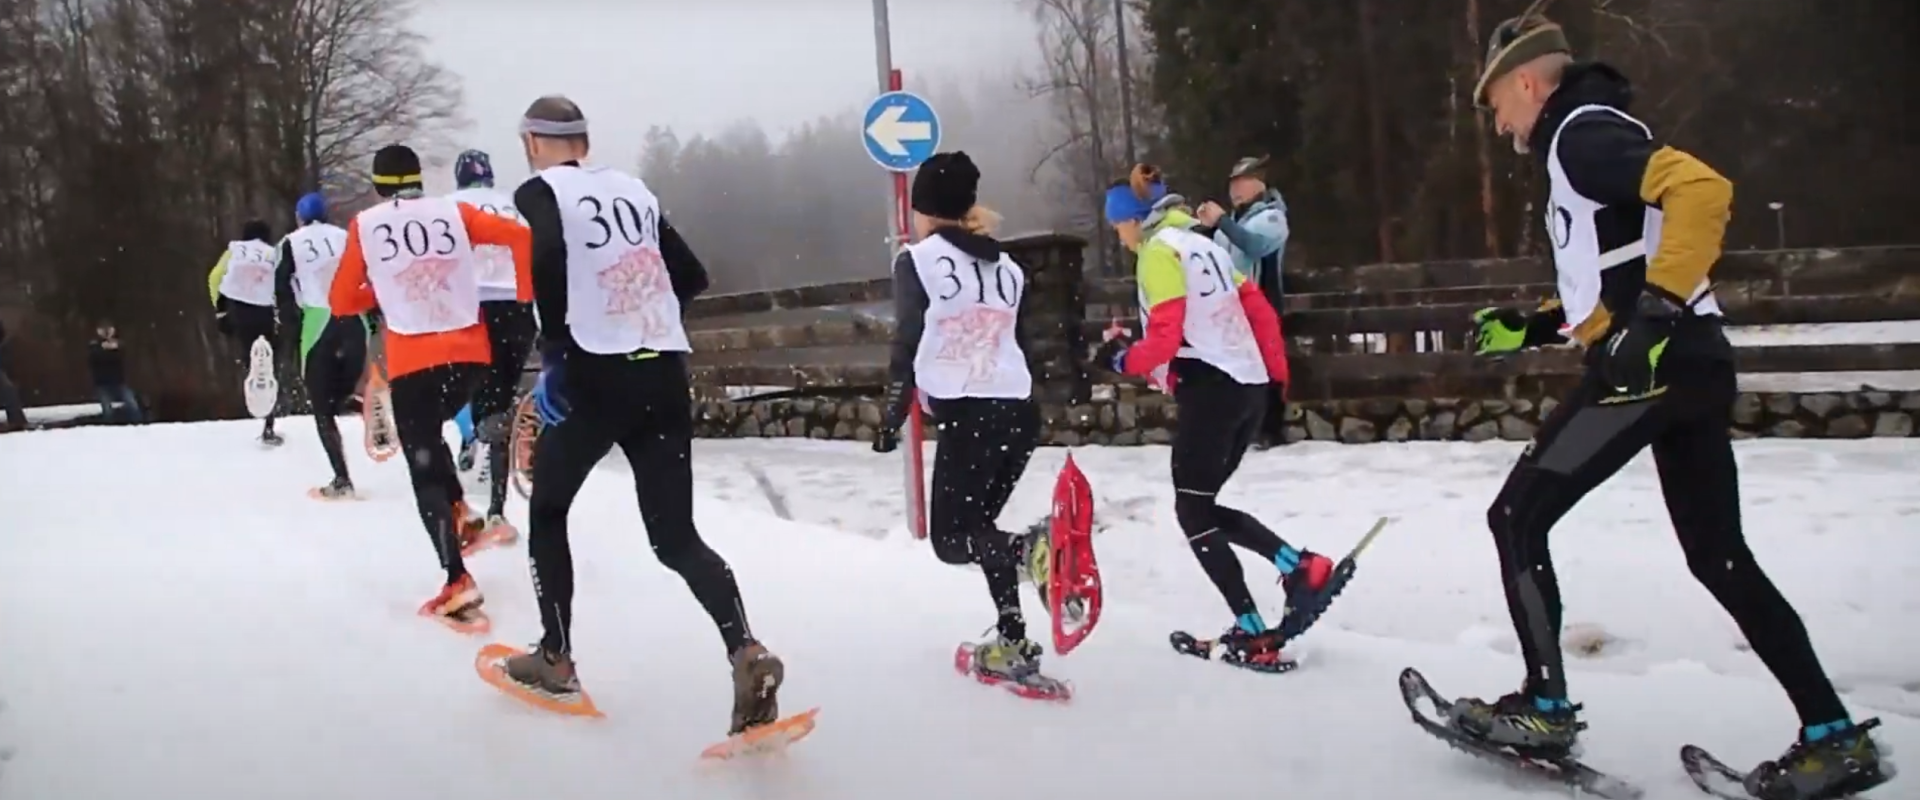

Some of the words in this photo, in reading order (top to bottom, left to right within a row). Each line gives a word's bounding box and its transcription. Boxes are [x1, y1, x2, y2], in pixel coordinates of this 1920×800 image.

[302, 237, 335, 263] 31
[372, 218, 456, 262] 303
[936, 255, 1018, 308] 310
[1190, 250, 1229, 297] 31
